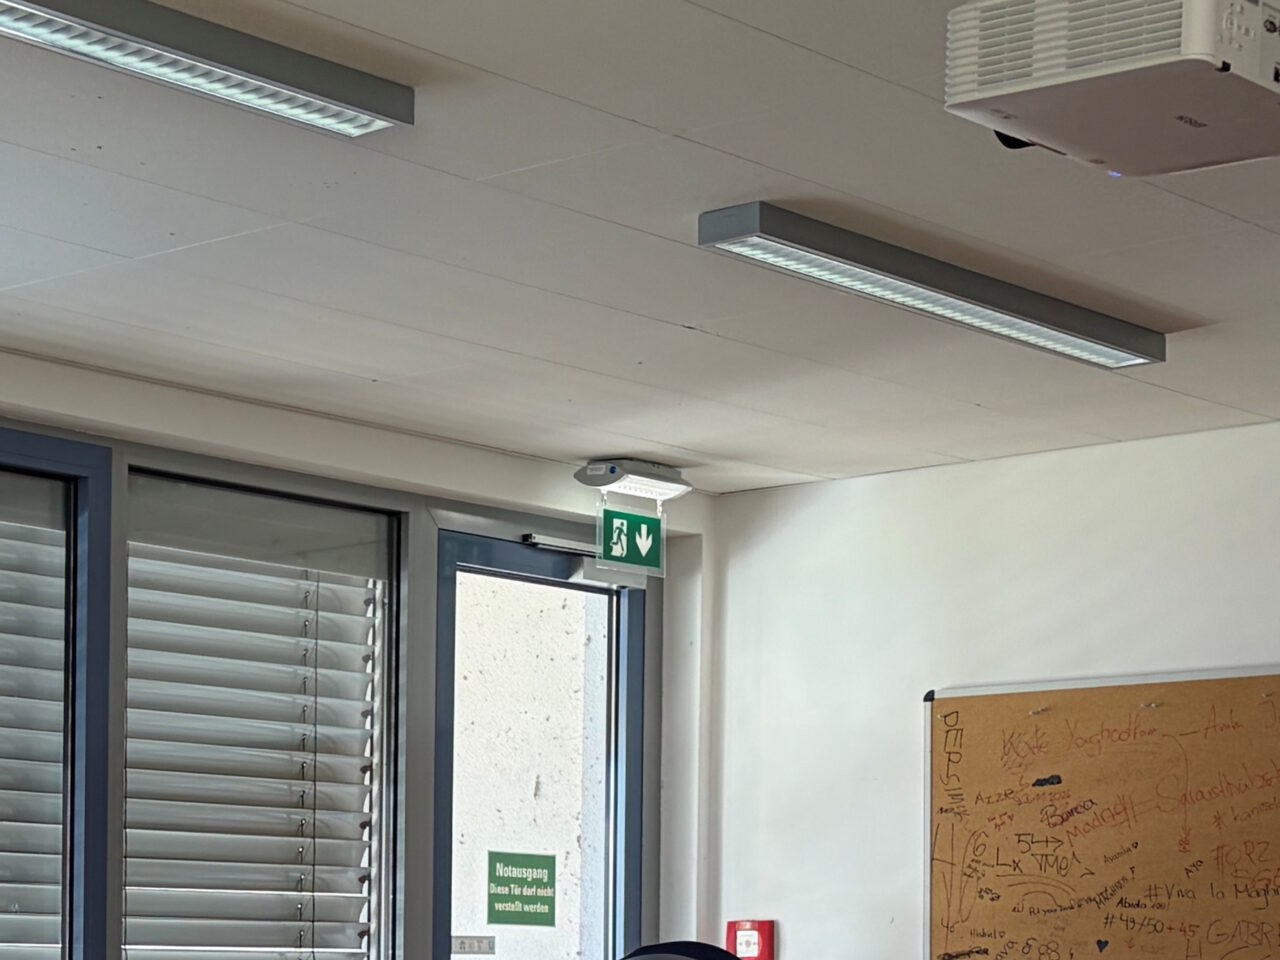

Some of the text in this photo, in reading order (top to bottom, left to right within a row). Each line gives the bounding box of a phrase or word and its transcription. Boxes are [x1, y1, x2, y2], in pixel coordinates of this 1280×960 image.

[495, 862, 549, 882] Notausgang
[489, 883, 554, 897] Diese Tür darf nicht
[494, 902, 549, 913] verstellt werden
